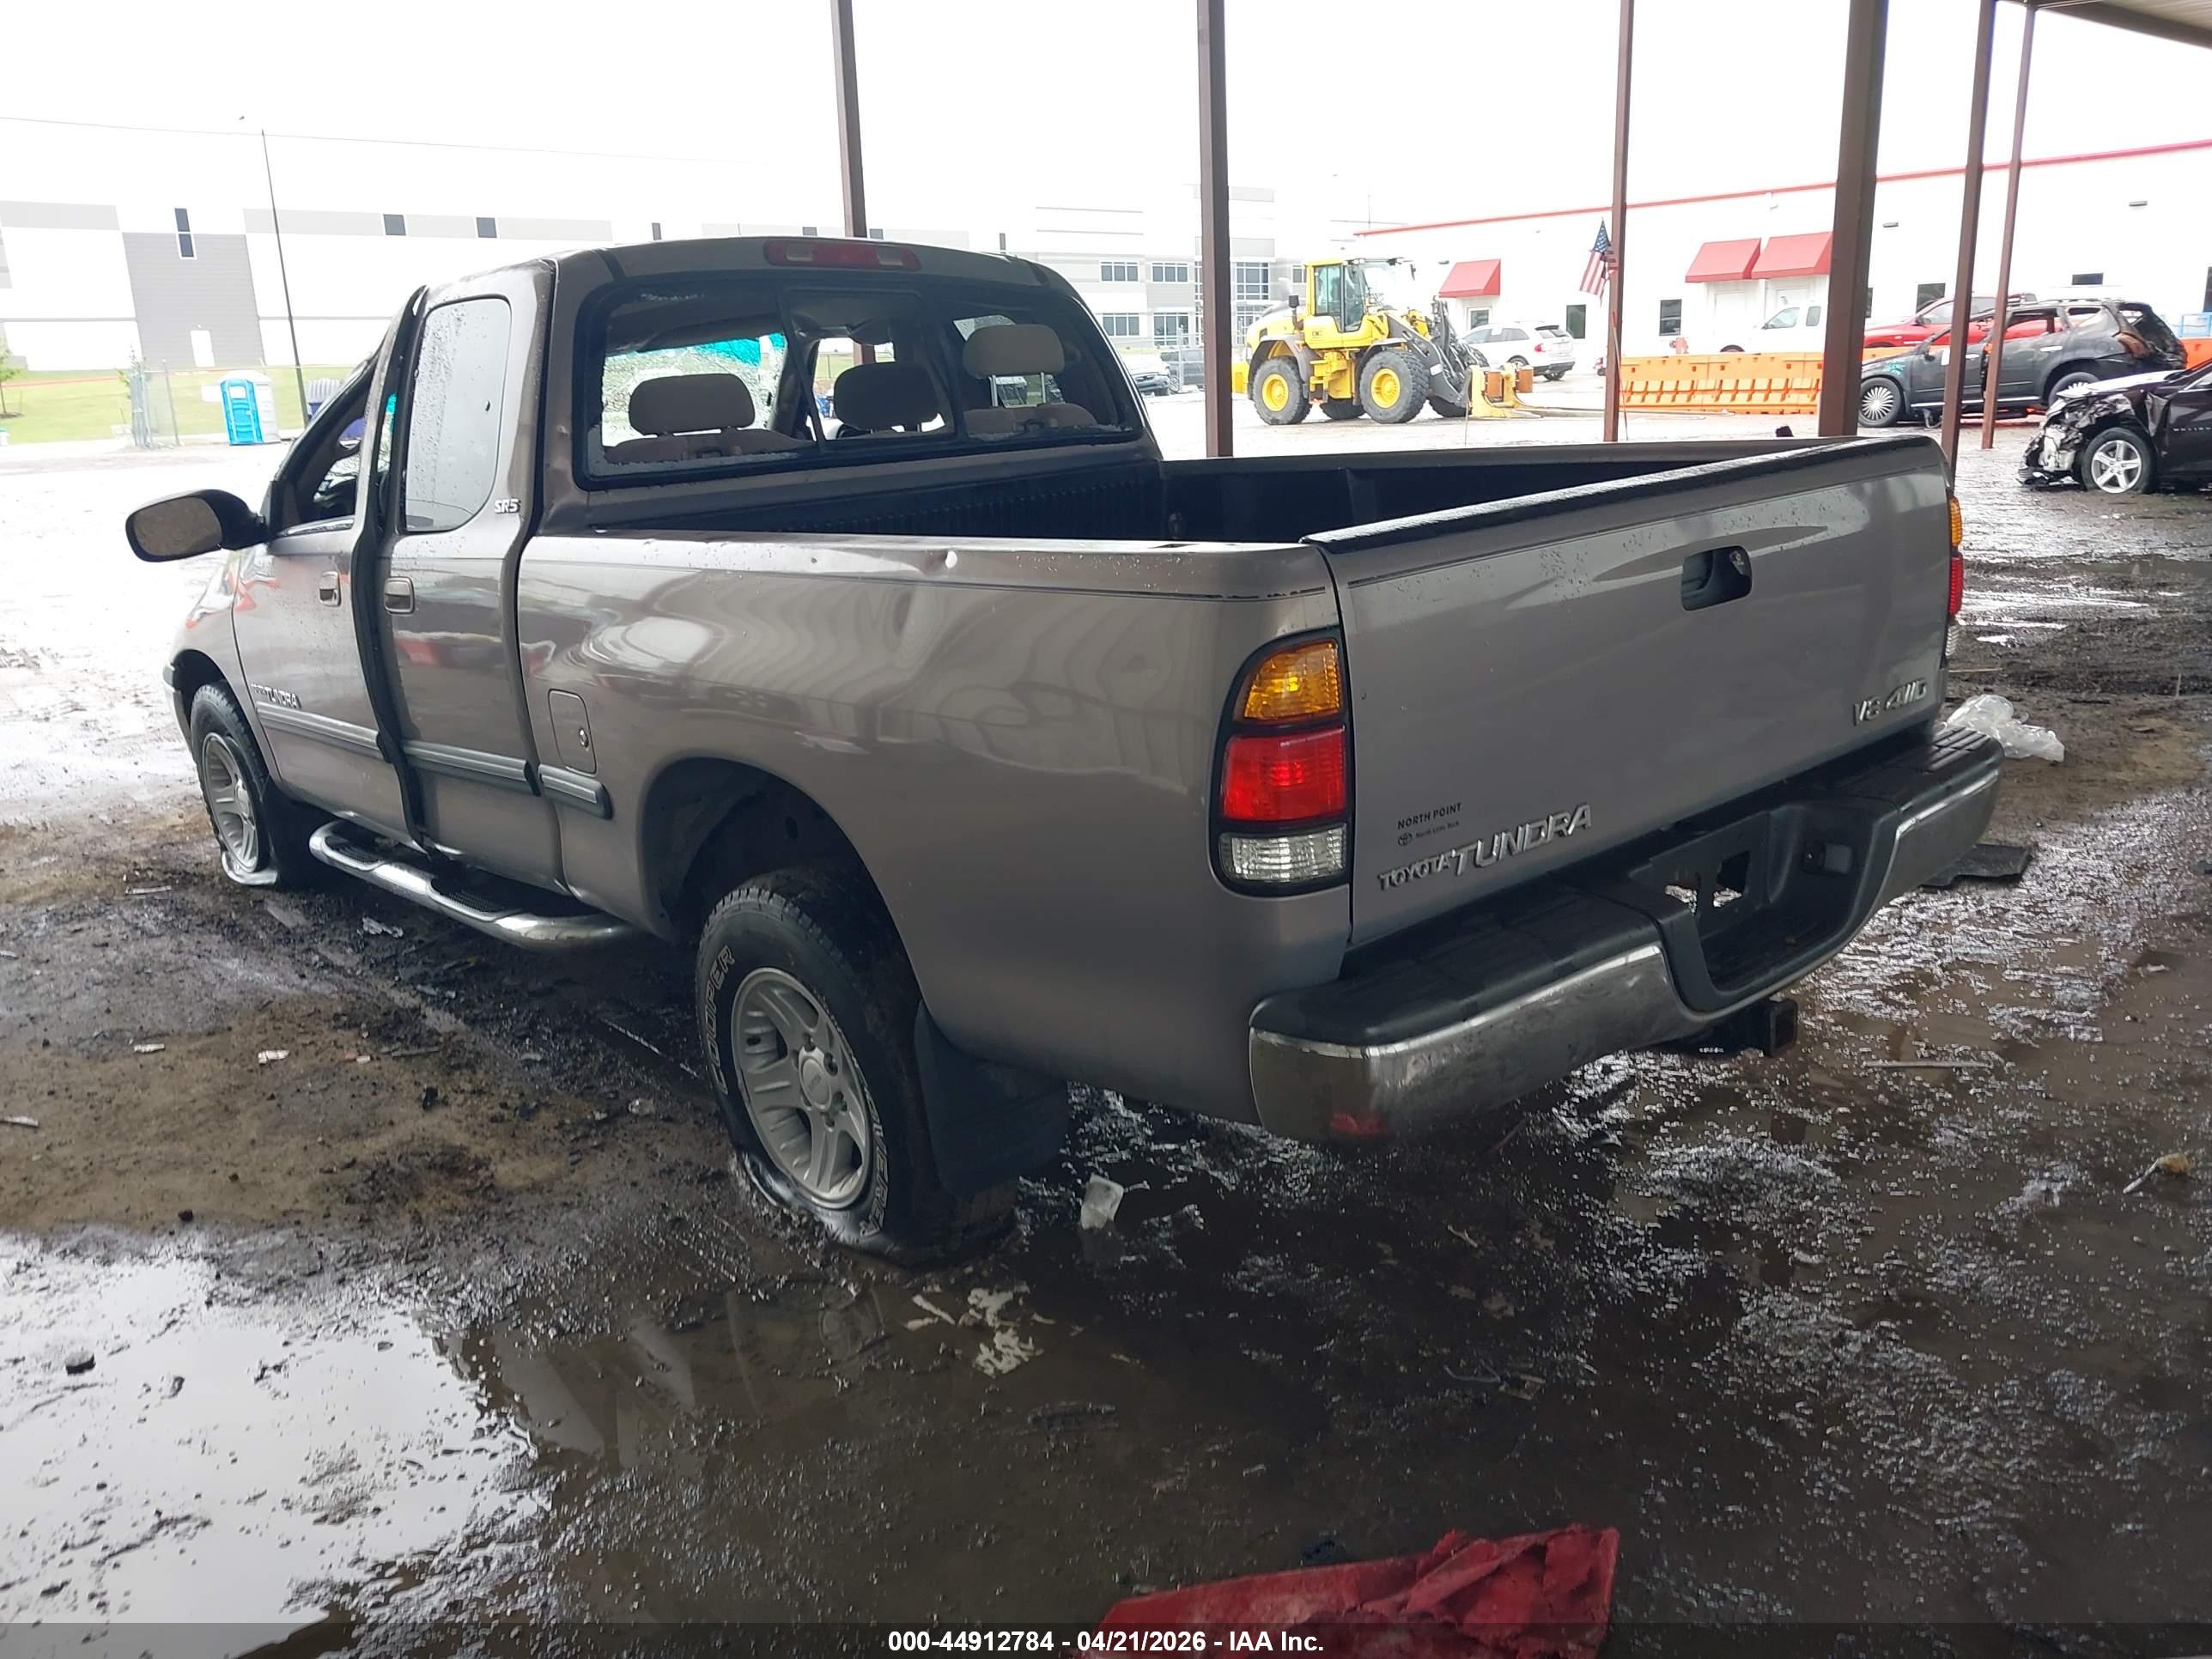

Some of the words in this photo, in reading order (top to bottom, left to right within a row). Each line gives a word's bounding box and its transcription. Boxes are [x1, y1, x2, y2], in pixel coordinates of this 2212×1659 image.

[495, 498, 520, 514] SR5
[1397, 811, 1431, 830] NORTH
[1433, 802, 1462, 820] POINT
[1377, 852, 1450, 890] TOYOTA
[1450, 801, 1592, 876] TUNDRA
[705, 945, 736, 1096] COOPER
